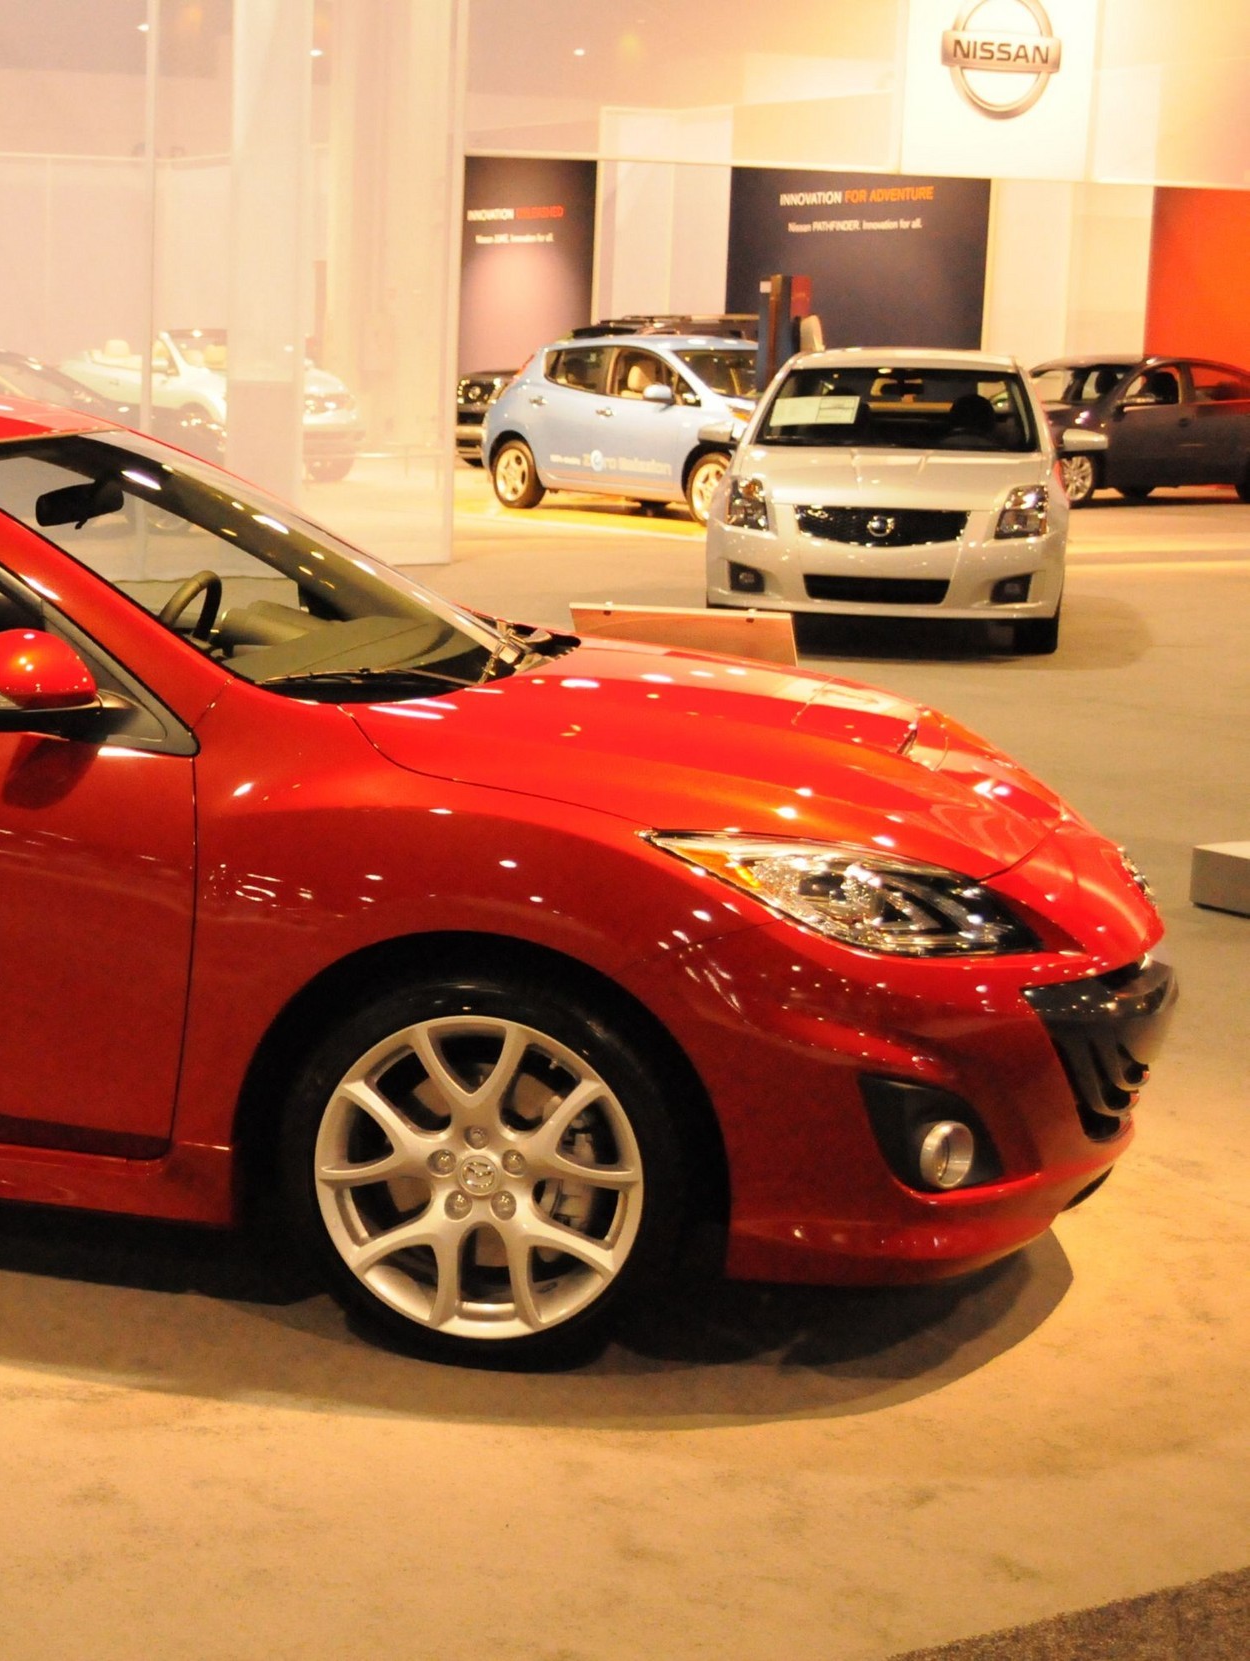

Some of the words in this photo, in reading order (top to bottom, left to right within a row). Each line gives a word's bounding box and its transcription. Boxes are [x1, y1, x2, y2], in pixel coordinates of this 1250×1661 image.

[953, 39, 1049, 65] NISSAN
[780, 191, 842, 206] INNOVATION
[845, 189, 868, 203] FOR
[870, 185, 934, 202] ADVENTURE
